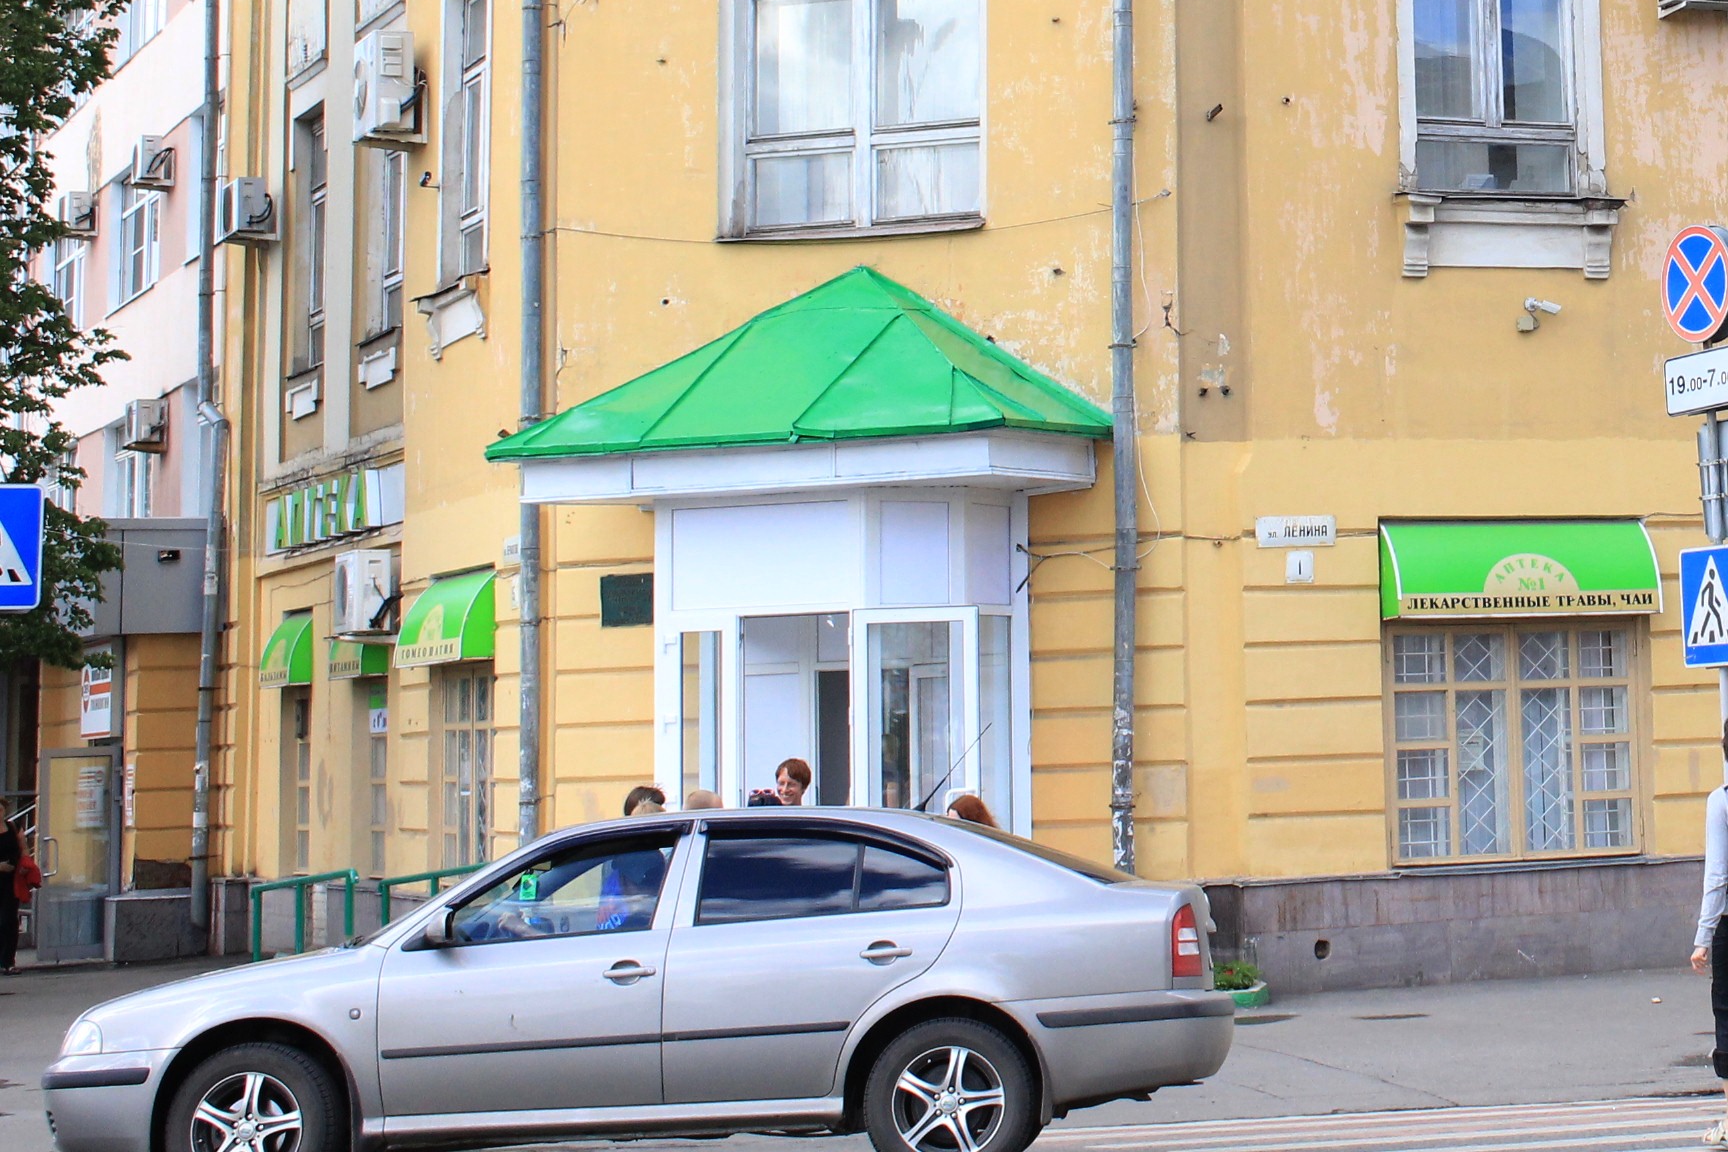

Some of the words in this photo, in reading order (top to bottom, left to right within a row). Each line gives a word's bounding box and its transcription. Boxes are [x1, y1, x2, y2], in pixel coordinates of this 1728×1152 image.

[275, 467, 369, 550] АПТЕКА
[1284, 525, 1328, 538] ЛЕНИНА
[1494, 557, 1566, 585] АПТЕКА
[1517, 576, 1546, 592] №1
[1407, 595, 1551, 611] ЛЕКАРСТВЕННЫЕ
[1556, 594, 1617, 608] ТРАВЫ,
[1620, 593, 1653, 606] ЧАИ
[401, 643, 454, 660] ГОМЕОПАТИЯ
